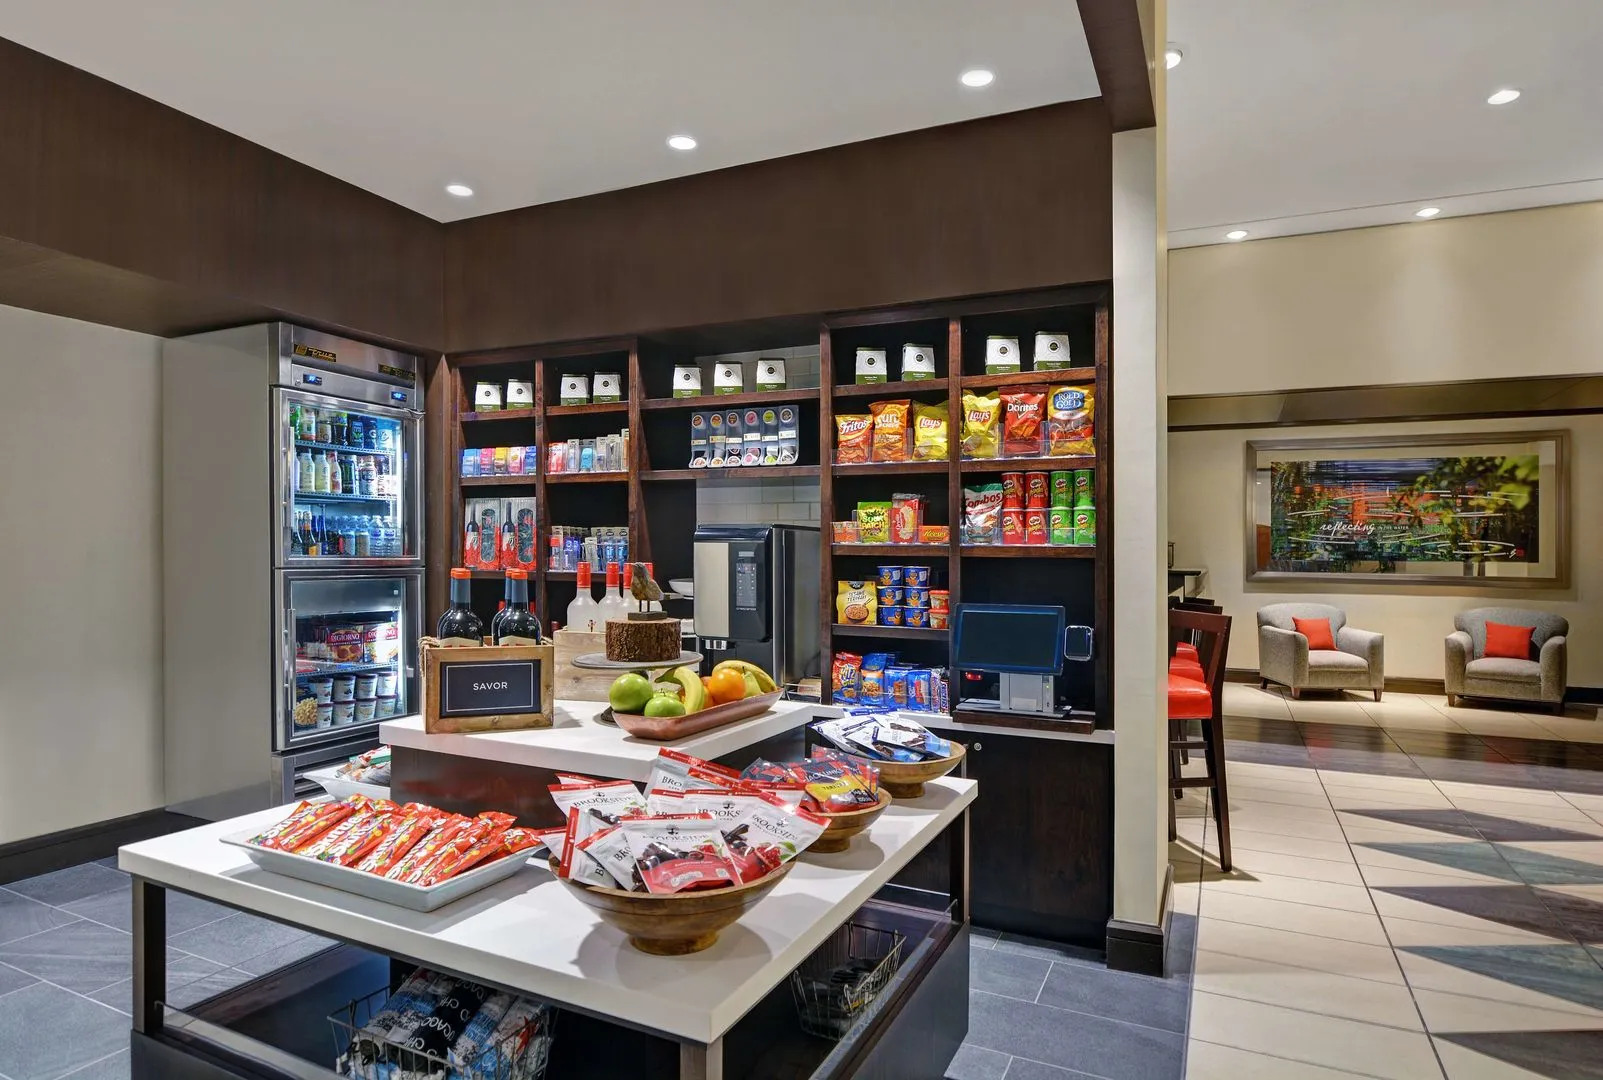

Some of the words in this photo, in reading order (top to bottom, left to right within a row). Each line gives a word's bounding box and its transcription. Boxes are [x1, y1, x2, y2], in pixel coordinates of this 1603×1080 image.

[1007, 403, 1039, 412] Doritos
[1056, 399, 1082, 409] GOLD
[840, 419, 869, 434] Fritos
[1320, 520, 1376, 540] reflecting
[472, 681, 508, 691] SAVOR
